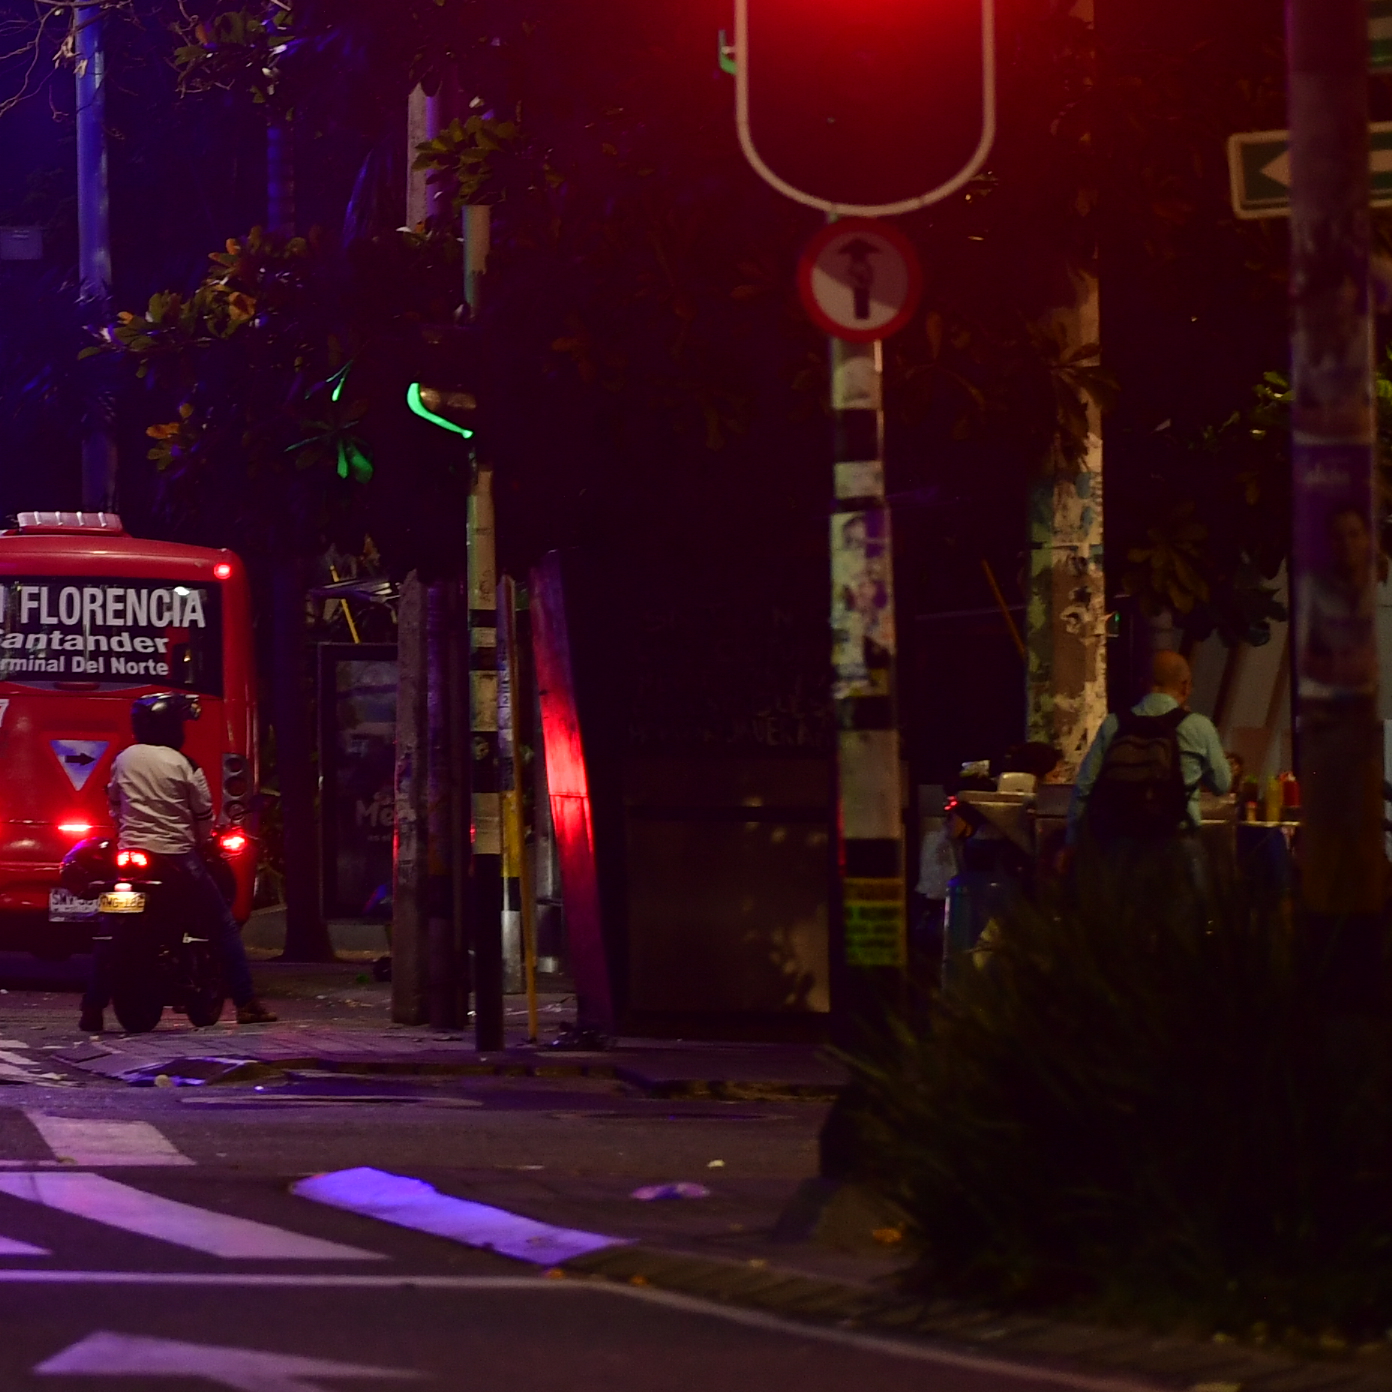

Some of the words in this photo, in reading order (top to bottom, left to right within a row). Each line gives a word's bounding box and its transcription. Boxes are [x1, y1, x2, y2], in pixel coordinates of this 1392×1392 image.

[20, 586, 206, 628] FLORENCIA
[71, 656, 104, 674] Del
[110, 657, 169, 675] Norte
